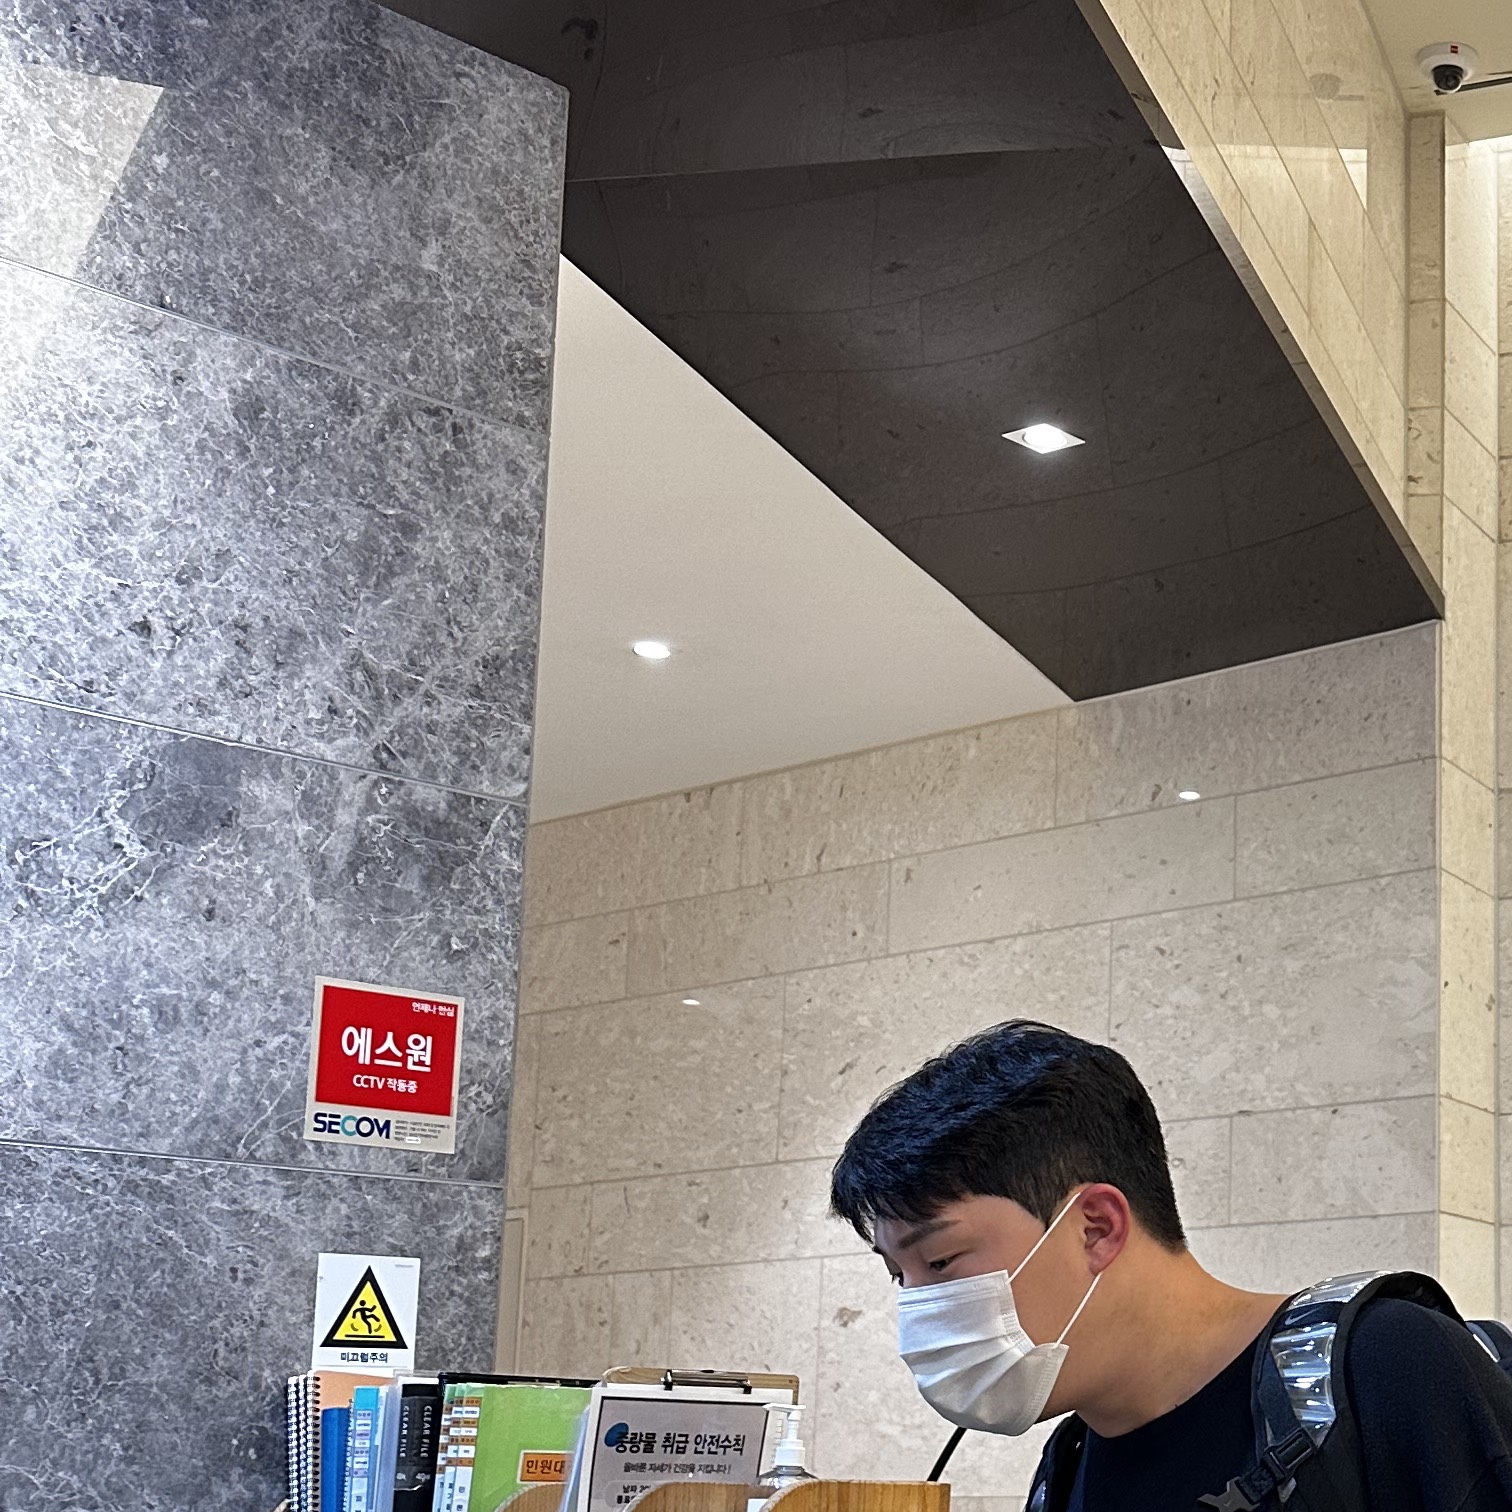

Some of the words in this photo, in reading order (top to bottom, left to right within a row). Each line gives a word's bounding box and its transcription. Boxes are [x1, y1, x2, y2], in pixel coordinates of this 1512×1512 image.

[341, 1026, 433, 1073] 에스원
[353, 1074, 385, 1090] CCTV
[386, 1078, 418, 1094] 작동중
[313, 1112, 391, 1140] SECOM
[340, 1352, 389, 1364] 미끄럼주의
[423, 1405, 432, 1435] CLEAR
[420, 1438, 429, 1458] FILE
[615, 1432, 657, 1453] 중량물
[661, 1433, 689, 1454] 취급
[694, 1434, 745, 1456] 안전수칙
[527, 1460, 568, 1475] 민원대
